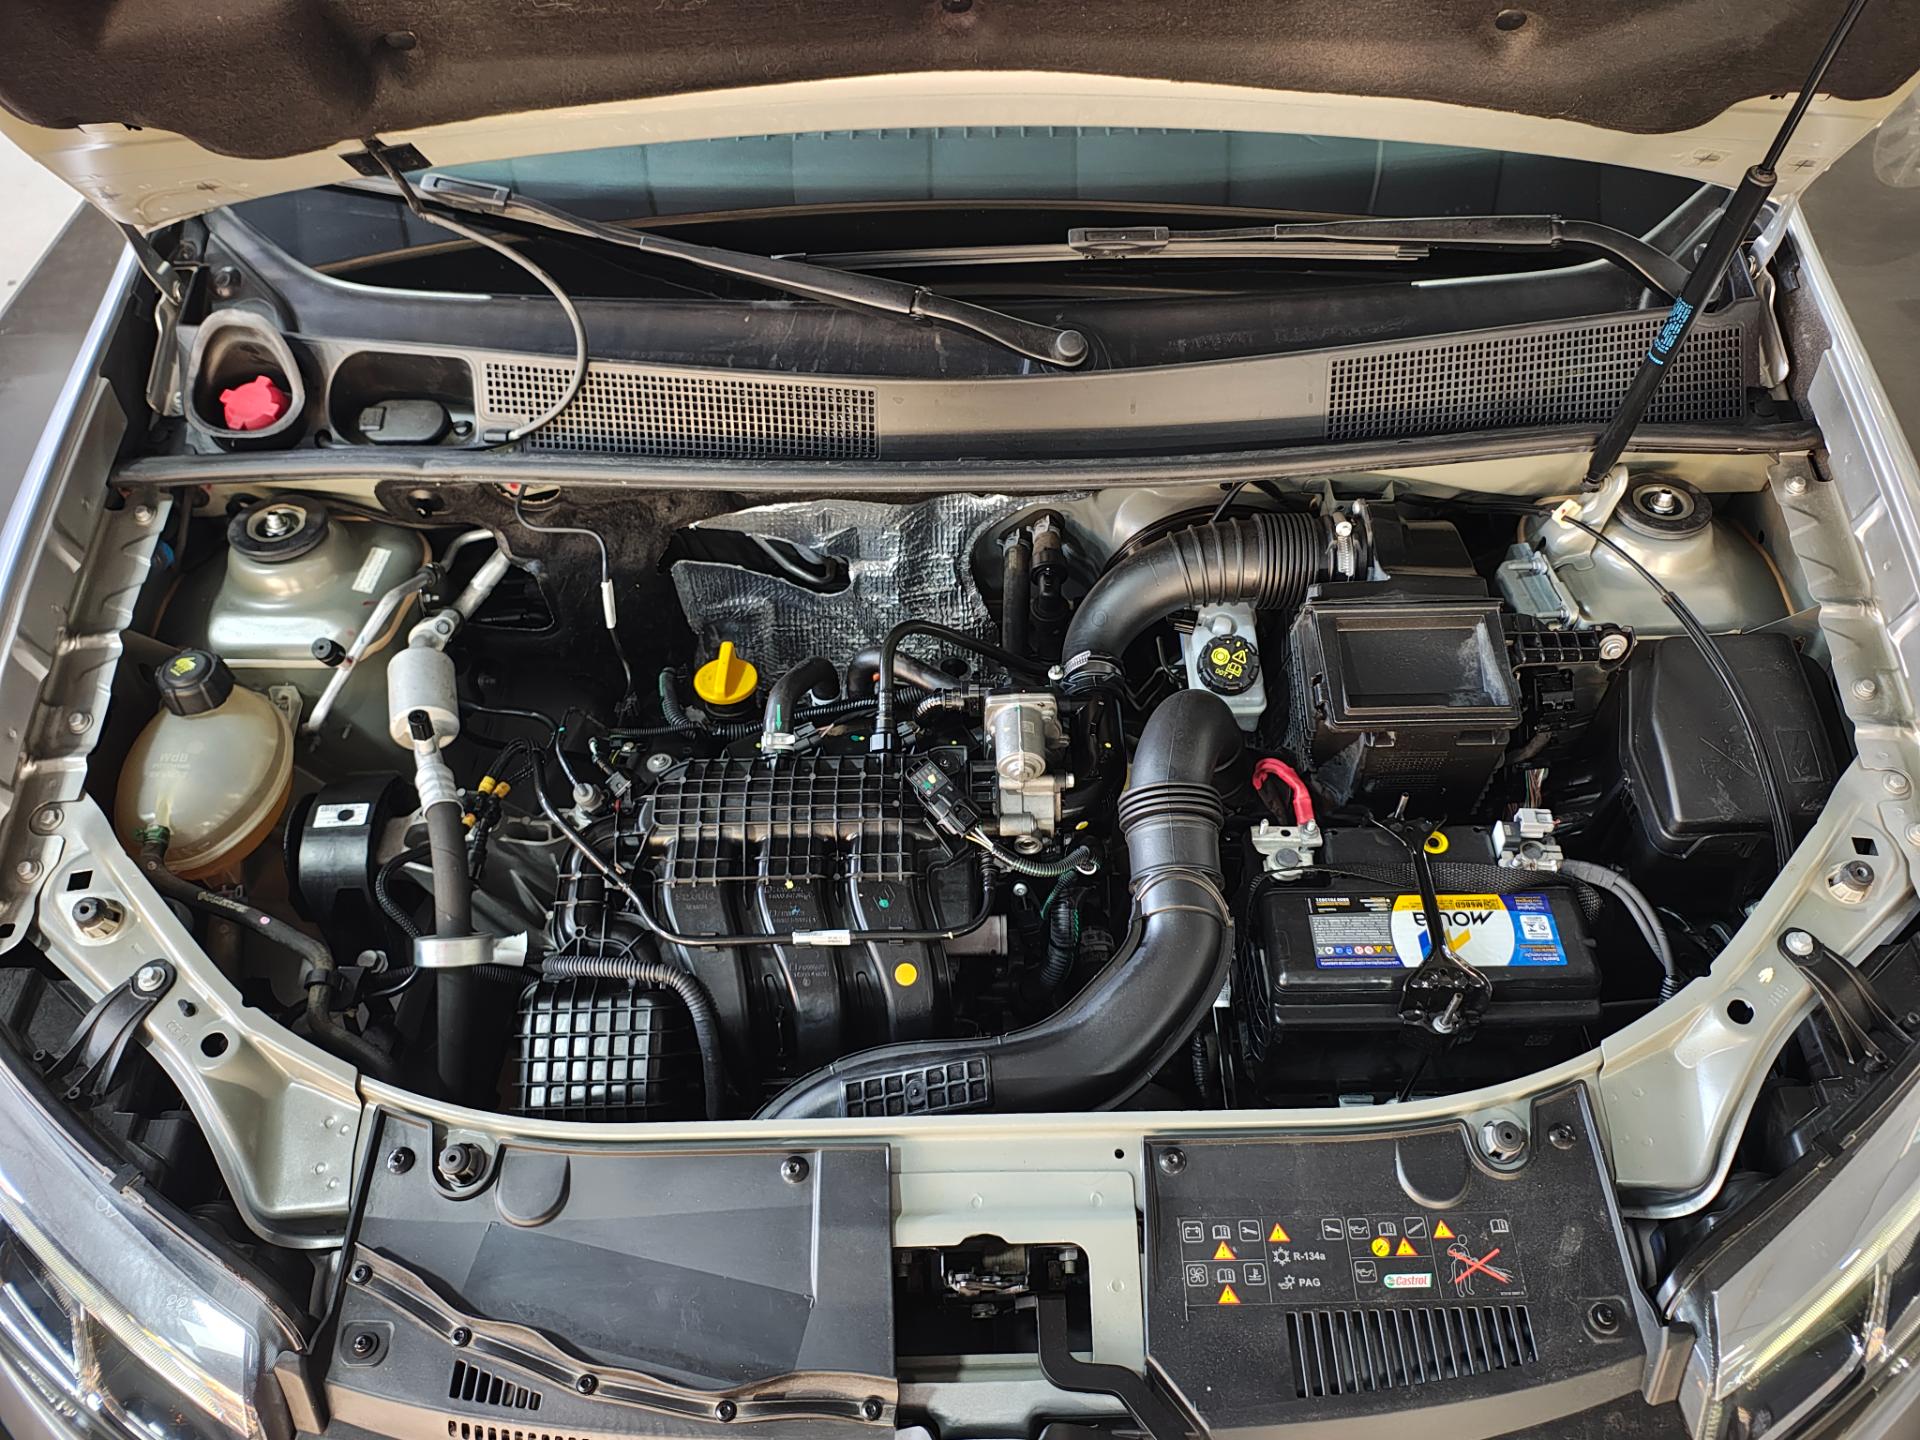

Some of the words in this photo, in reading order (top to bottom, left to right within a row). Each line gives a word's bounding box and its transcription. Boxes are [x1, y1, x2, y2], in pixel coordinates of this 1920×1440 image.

[1215, 668, 1228, 677] DOT
[1293, 1251, 1326, 1261] R-134a
[1298, 1278, 1321, 1287] PAG
[1396, 1276, 1428, 1286] Castrol
